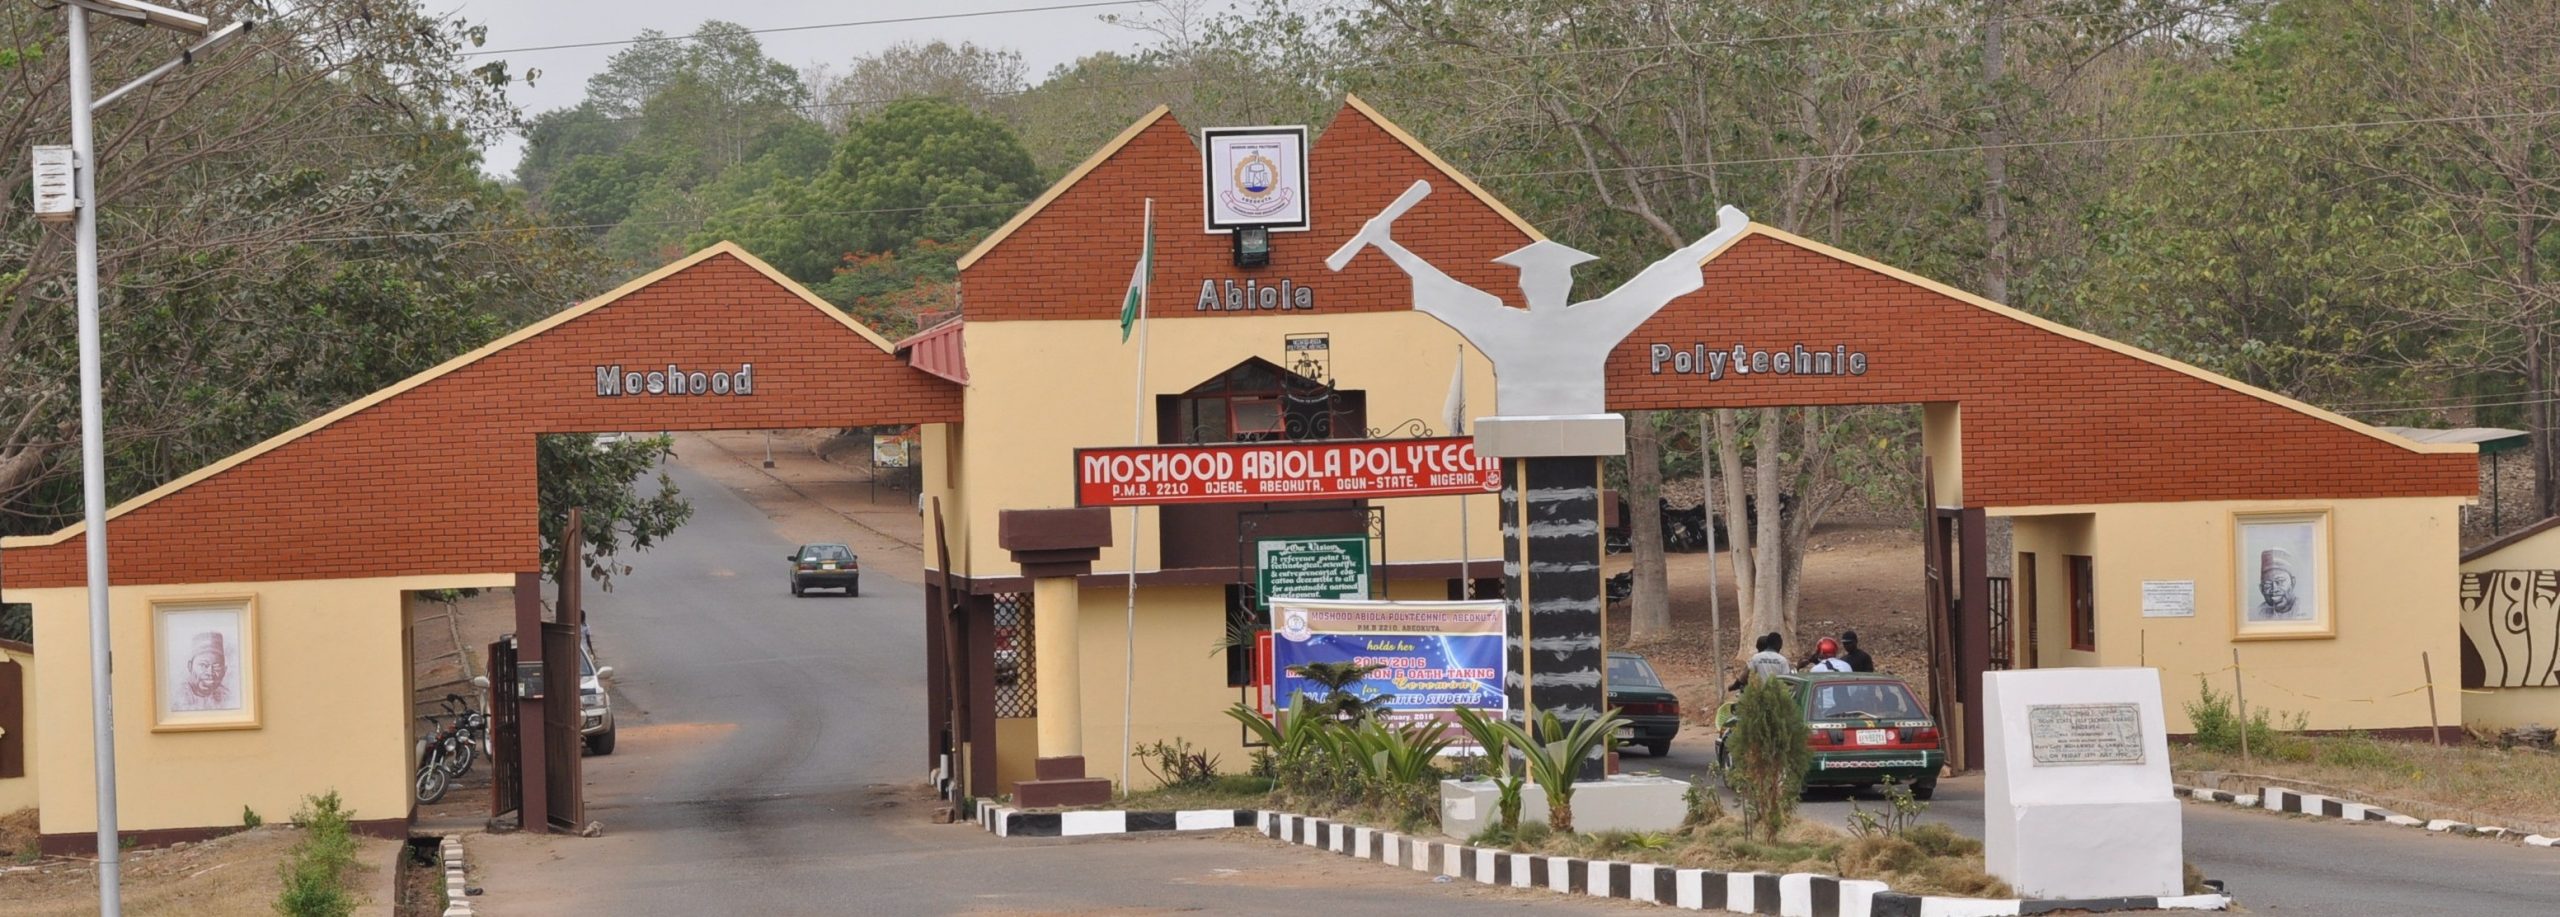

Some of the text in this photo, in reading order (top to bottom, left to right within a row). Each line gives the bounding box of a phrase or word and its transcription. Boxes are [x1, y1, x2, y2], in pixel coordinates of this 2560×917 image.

[1197, 279, 1313, 311] Abiola
[1650, 343, 1868, 381] Polytechnic
[596, 363, 753, 396] Moshood
[1084, 443, 1500, 484] MOSHOOD ABIOLA POLYTEC
[1112, 473, 1479, 497] P.M.B. 2210 OJERE, ABEOKUTA, OGUN-STATE, NIGERIA.
[1280, 555, 1315, 563] reference
[1317, 555, 1339, 564] point
[1312, 612, 1353, 621] MOSHOOD
[1355, 612, 1385, 621] ABIOLA
[1366, 639, 1415, 651] holds her
[1353, 656, 1426, 669] 2015/2016
[1395, 669, 1404, 680] &
[1362, 684, 1379, 696] for
[1392, 676, 1481, 692] Ceremony
[1425, 693, 1482, 705] STUDENTS
